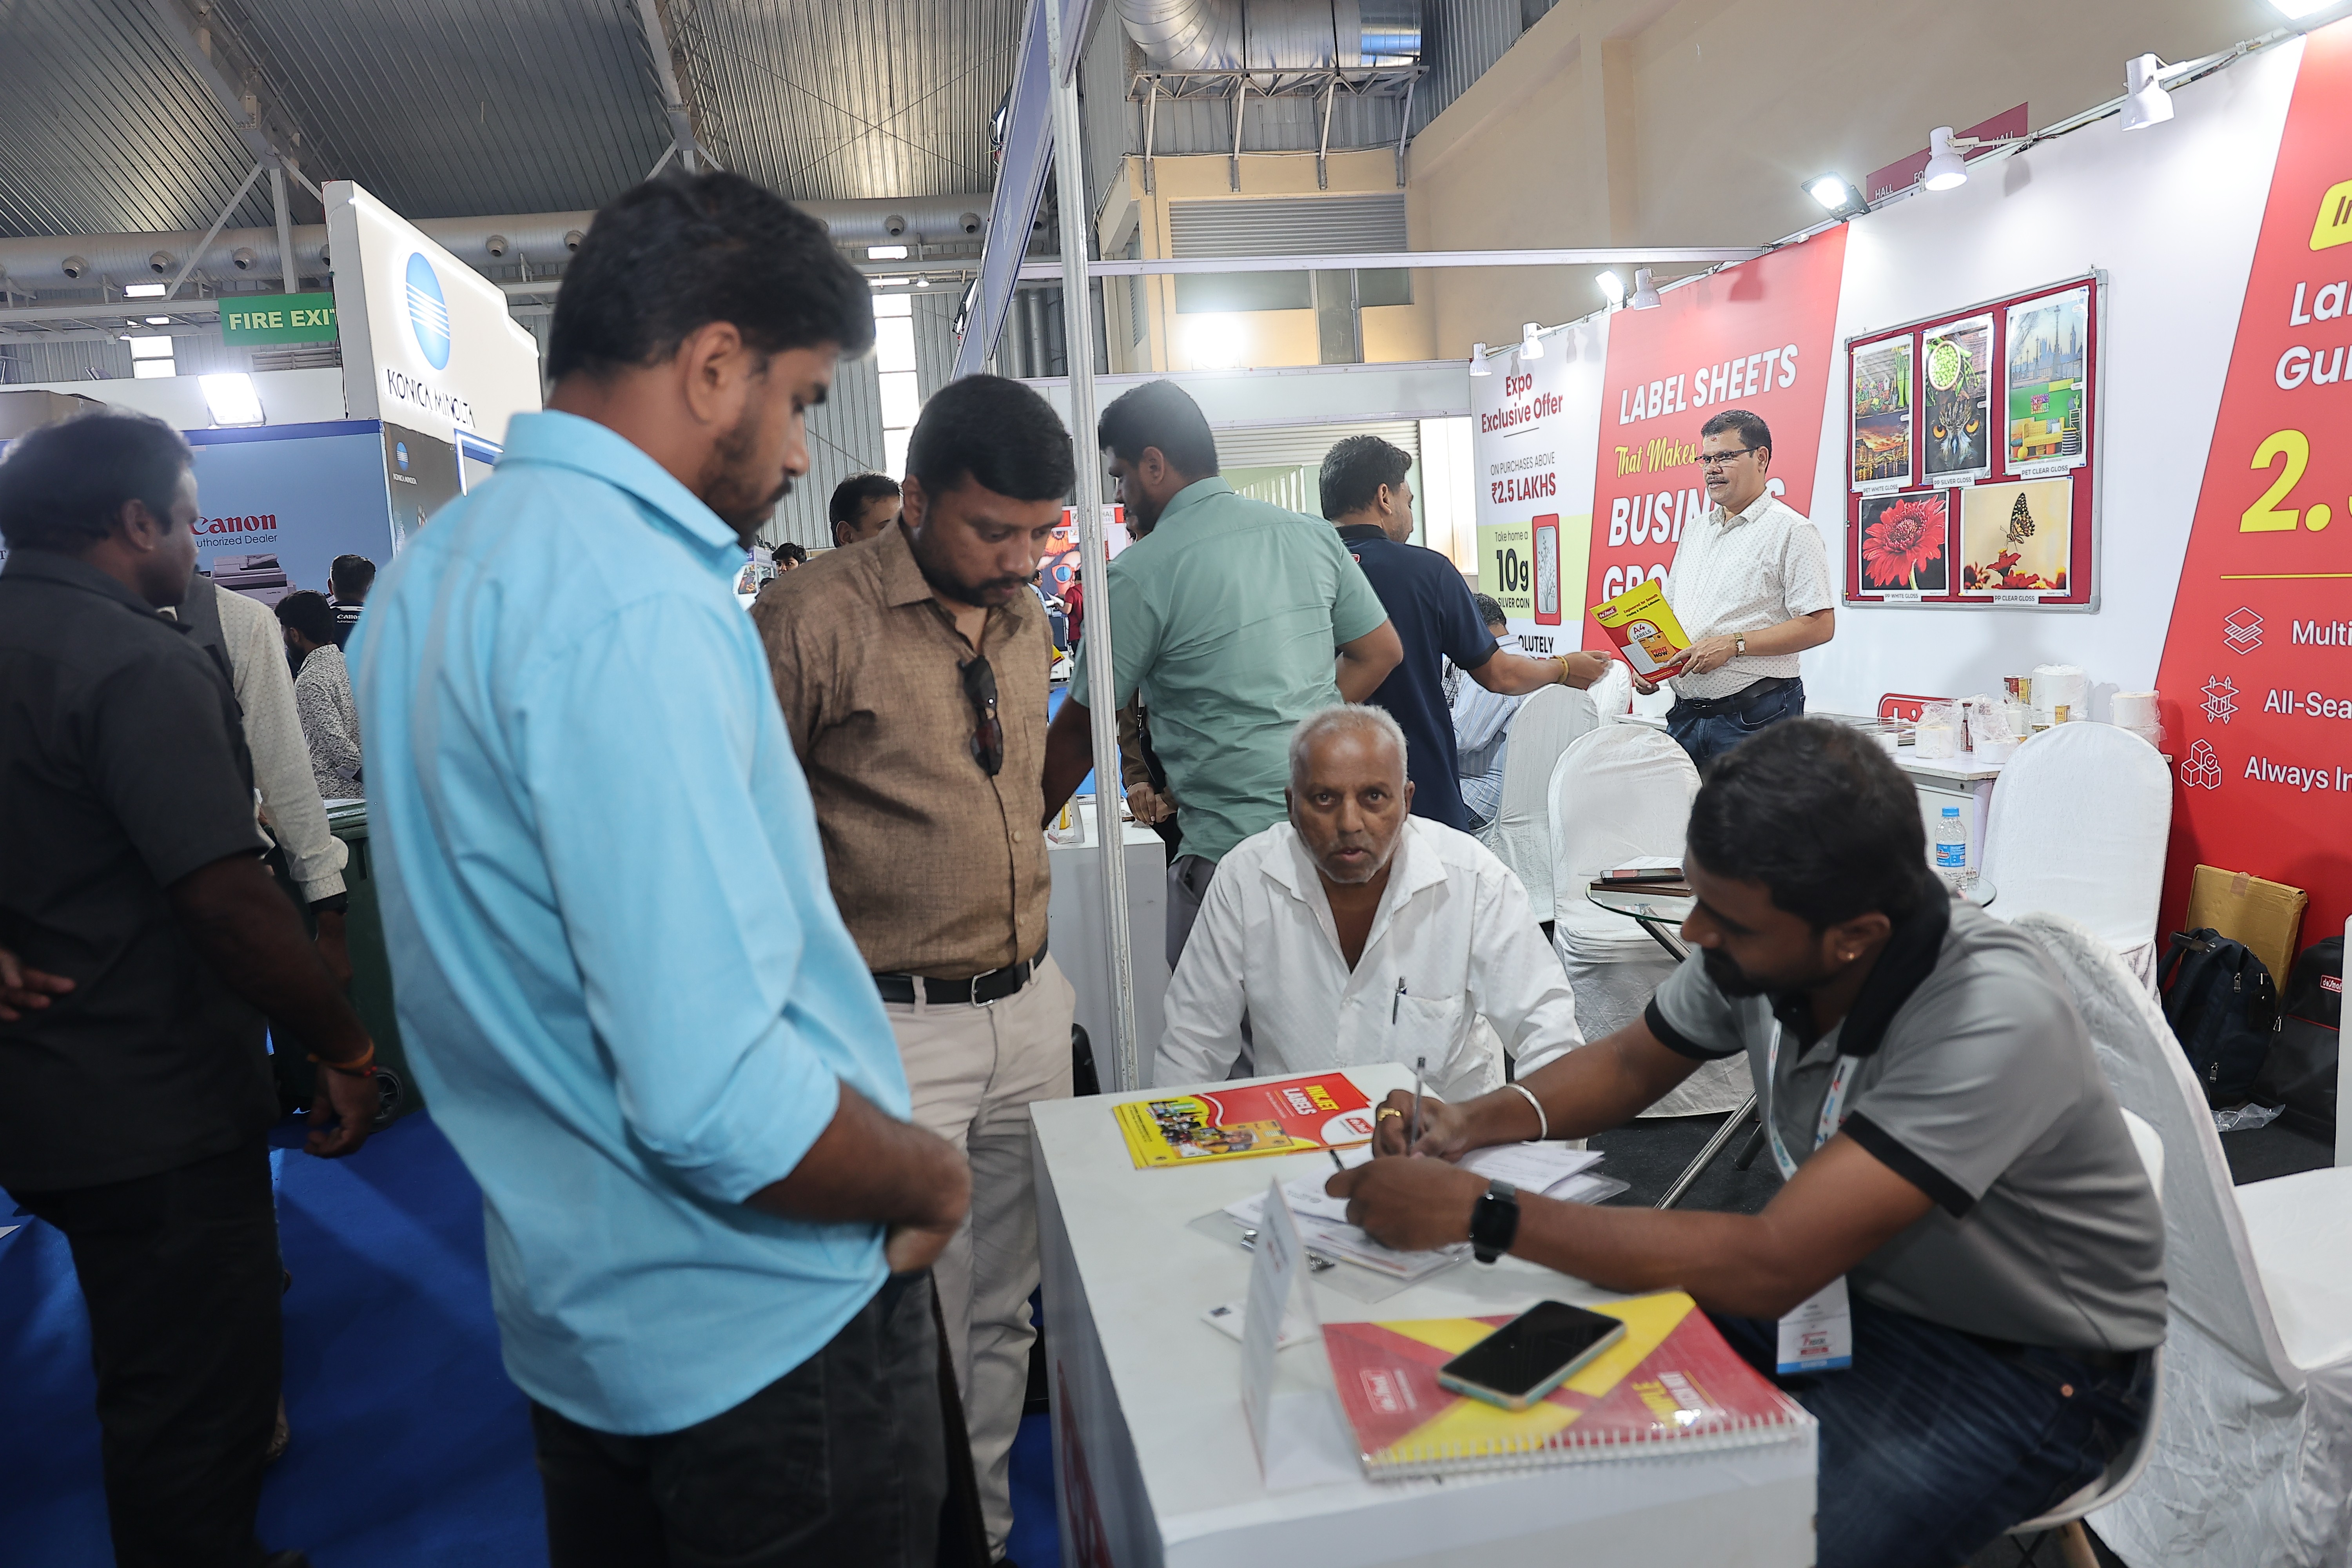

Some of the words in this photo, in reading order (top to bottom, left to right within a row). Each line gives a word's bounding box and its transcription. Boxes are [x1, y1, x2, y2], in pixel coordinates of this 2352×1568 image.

[1875, 183, 1893, 199] HALL
[229, 311, 283, 330] FIRE
[1506, 373, 1532, 400] Expo
[1619, 374, 1687, 425] LABEL
[1692, 343, 1798, 408] SHEETS
[387, 368, 433, 410] KONICA
[434, 388, 475, 428] MINOLTA
[1482, 402, 1531, 433] Exclusive
[1534, 391, 1563, 419] Offer
[1491, 464, 1499, 475] ON
[1500, 457, 1533, 474] PURCHASES
[1535, 452, 1555, 467] ABOVE
[1614, 445, 1643, 479] That
[1646, 436, 1698, 473] Makes
[393, 473, 405, 482] KONICA
[1492, 479, 1514, 504] ₹2.5
[1517, 472, 1556, 501] LAKHS
[191, 514, 277, 535] Canon
[196, 535, 242, 548] uthorized
[245, 534, 278, 544] Dealer
[1495, 532, 1507, 542] Take
[1508, 530, 1523, 541] home
[1524, 531, 1528, 540] a
[1498, 597, 1515, 608] SILVER
[1516, 597, 1530, 608] COIN
[1623, 602, 1641, 613] Engineered
[1645, 594, 1658, 602] Smooth
[1633, 624, 1645, 634] A4
[1633, 629, 1651, 640] LABELS
[2243, 755, 2329, 793] Always
[1282, 1087, 1318, 1115] LABELS
[1304, 1084, 1340, 1111] INKJET
